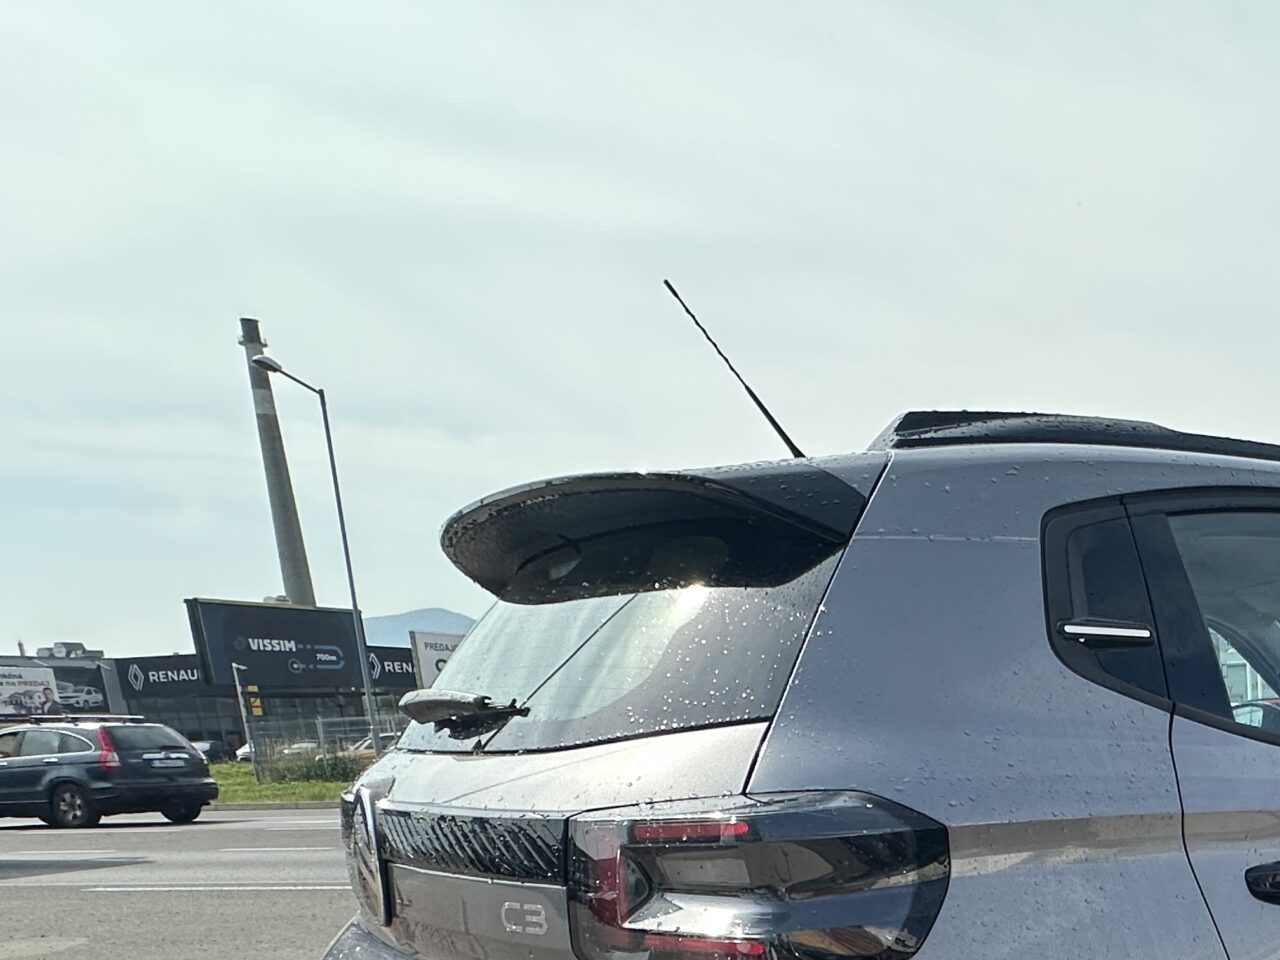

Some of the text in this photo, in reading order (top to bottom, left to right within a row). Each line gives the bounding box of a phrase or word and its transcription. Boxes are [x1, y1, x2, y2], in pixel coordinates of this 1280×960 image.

[248, 638, 297, 652] VISSIM
[383, 661, 416, 673] REN
[148, 669, 201, 683] RENAU
[501, 901, 548, 935] C3
